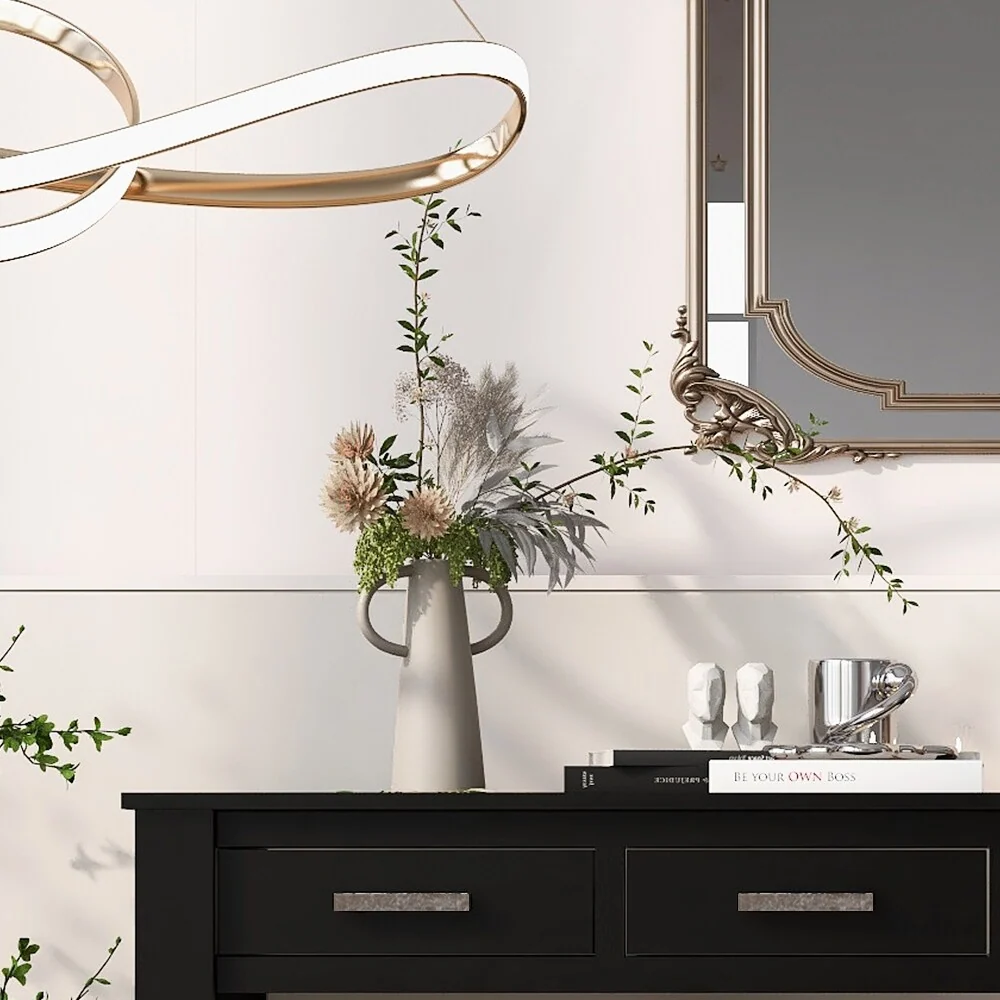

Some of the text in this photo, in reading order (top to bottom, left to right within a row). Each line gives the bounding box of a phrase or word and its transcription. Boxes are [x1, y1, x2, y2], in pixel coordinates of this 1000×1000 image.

[733, 771, 857, 782] BE YOUR OWN BOSS
